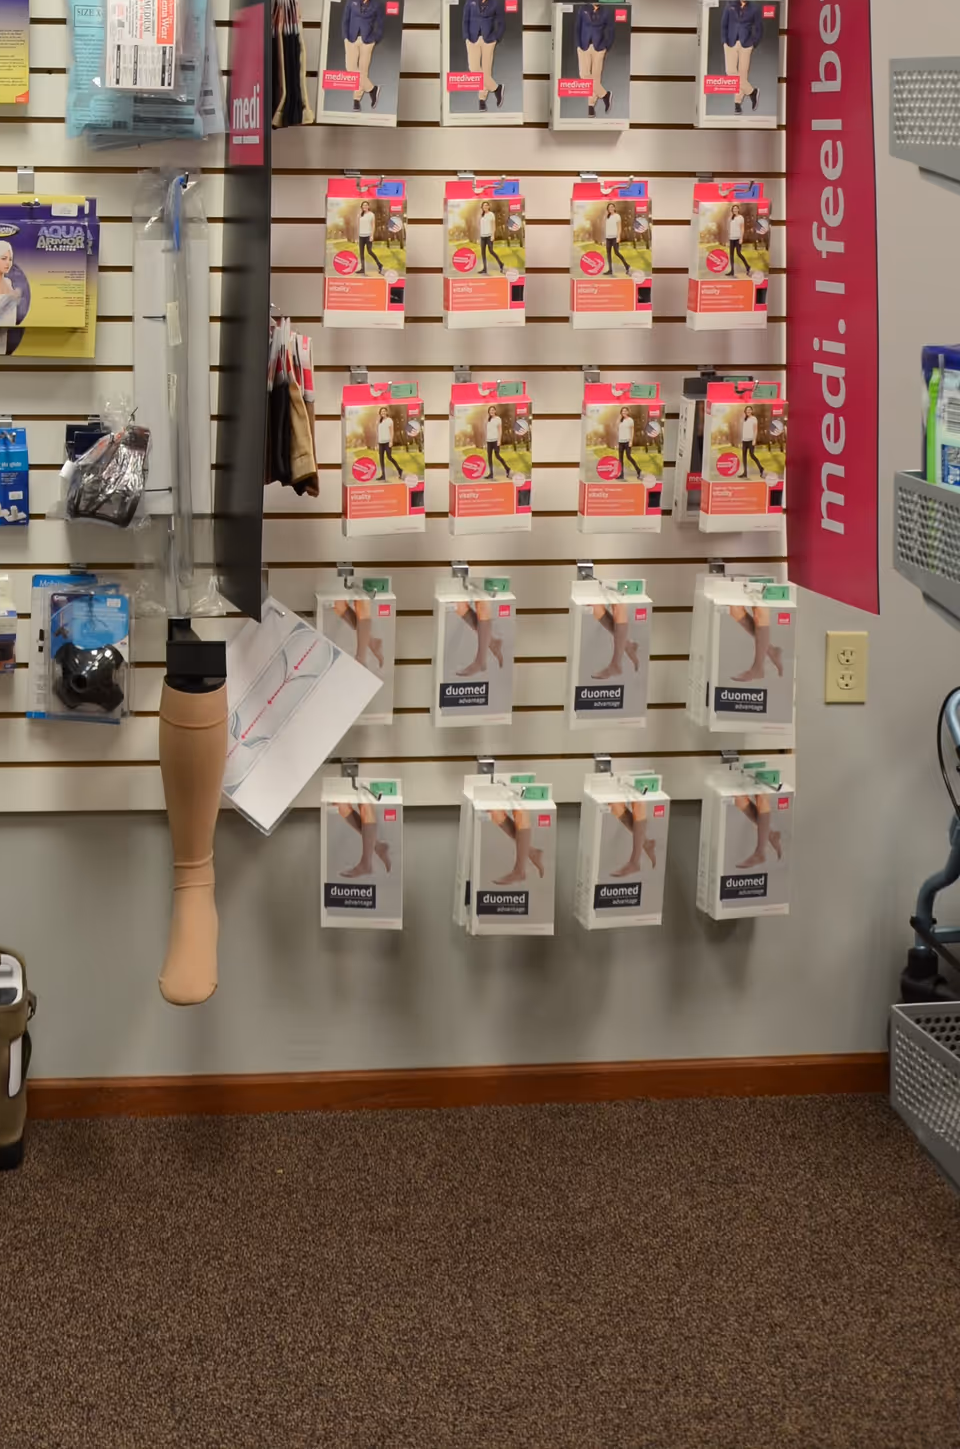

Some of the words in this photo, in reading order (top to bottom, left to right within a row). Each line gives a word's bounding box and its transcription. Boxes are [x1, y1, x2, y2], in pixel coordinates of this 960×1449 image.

[77, 8, 94, 16] SIZE
[233, 85, 260, 130] medi
[811, 118, 847, 258] feel
[38, 226, 85, 238] AQUA
[36, 236, 85, 248] ARMOR
[812, 317, 848, 536] medi.
[446, 684, 486, 695] duomed
[581, 688, 621, 699] duomed
[721, 690, 764, 702] duomed
[726, 878, 764, 888] duomed
[331, 887, 372, 897] duomed
[600, 886, 639, 896] duomed
[483, 894, 525, 904] duomed
